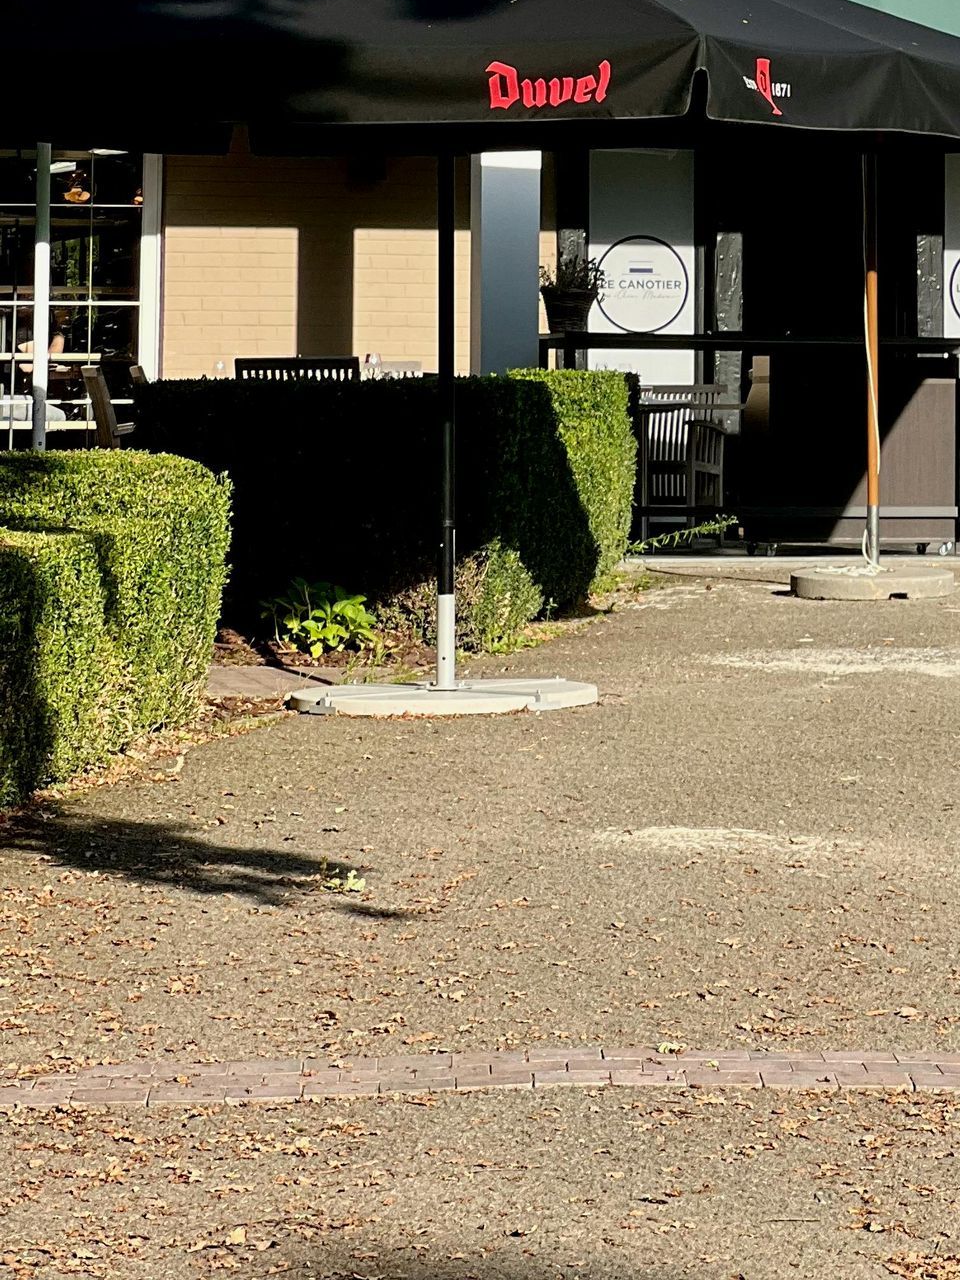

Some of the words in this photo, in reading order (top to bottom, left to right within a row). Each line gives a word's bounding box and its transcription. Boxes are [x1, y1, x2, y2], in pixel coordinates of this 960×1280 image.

[485, 60, 611, 110] Duvel
[771, 82, 791, 97] 1871
[618, 280, 682, 290] CANOTIER
